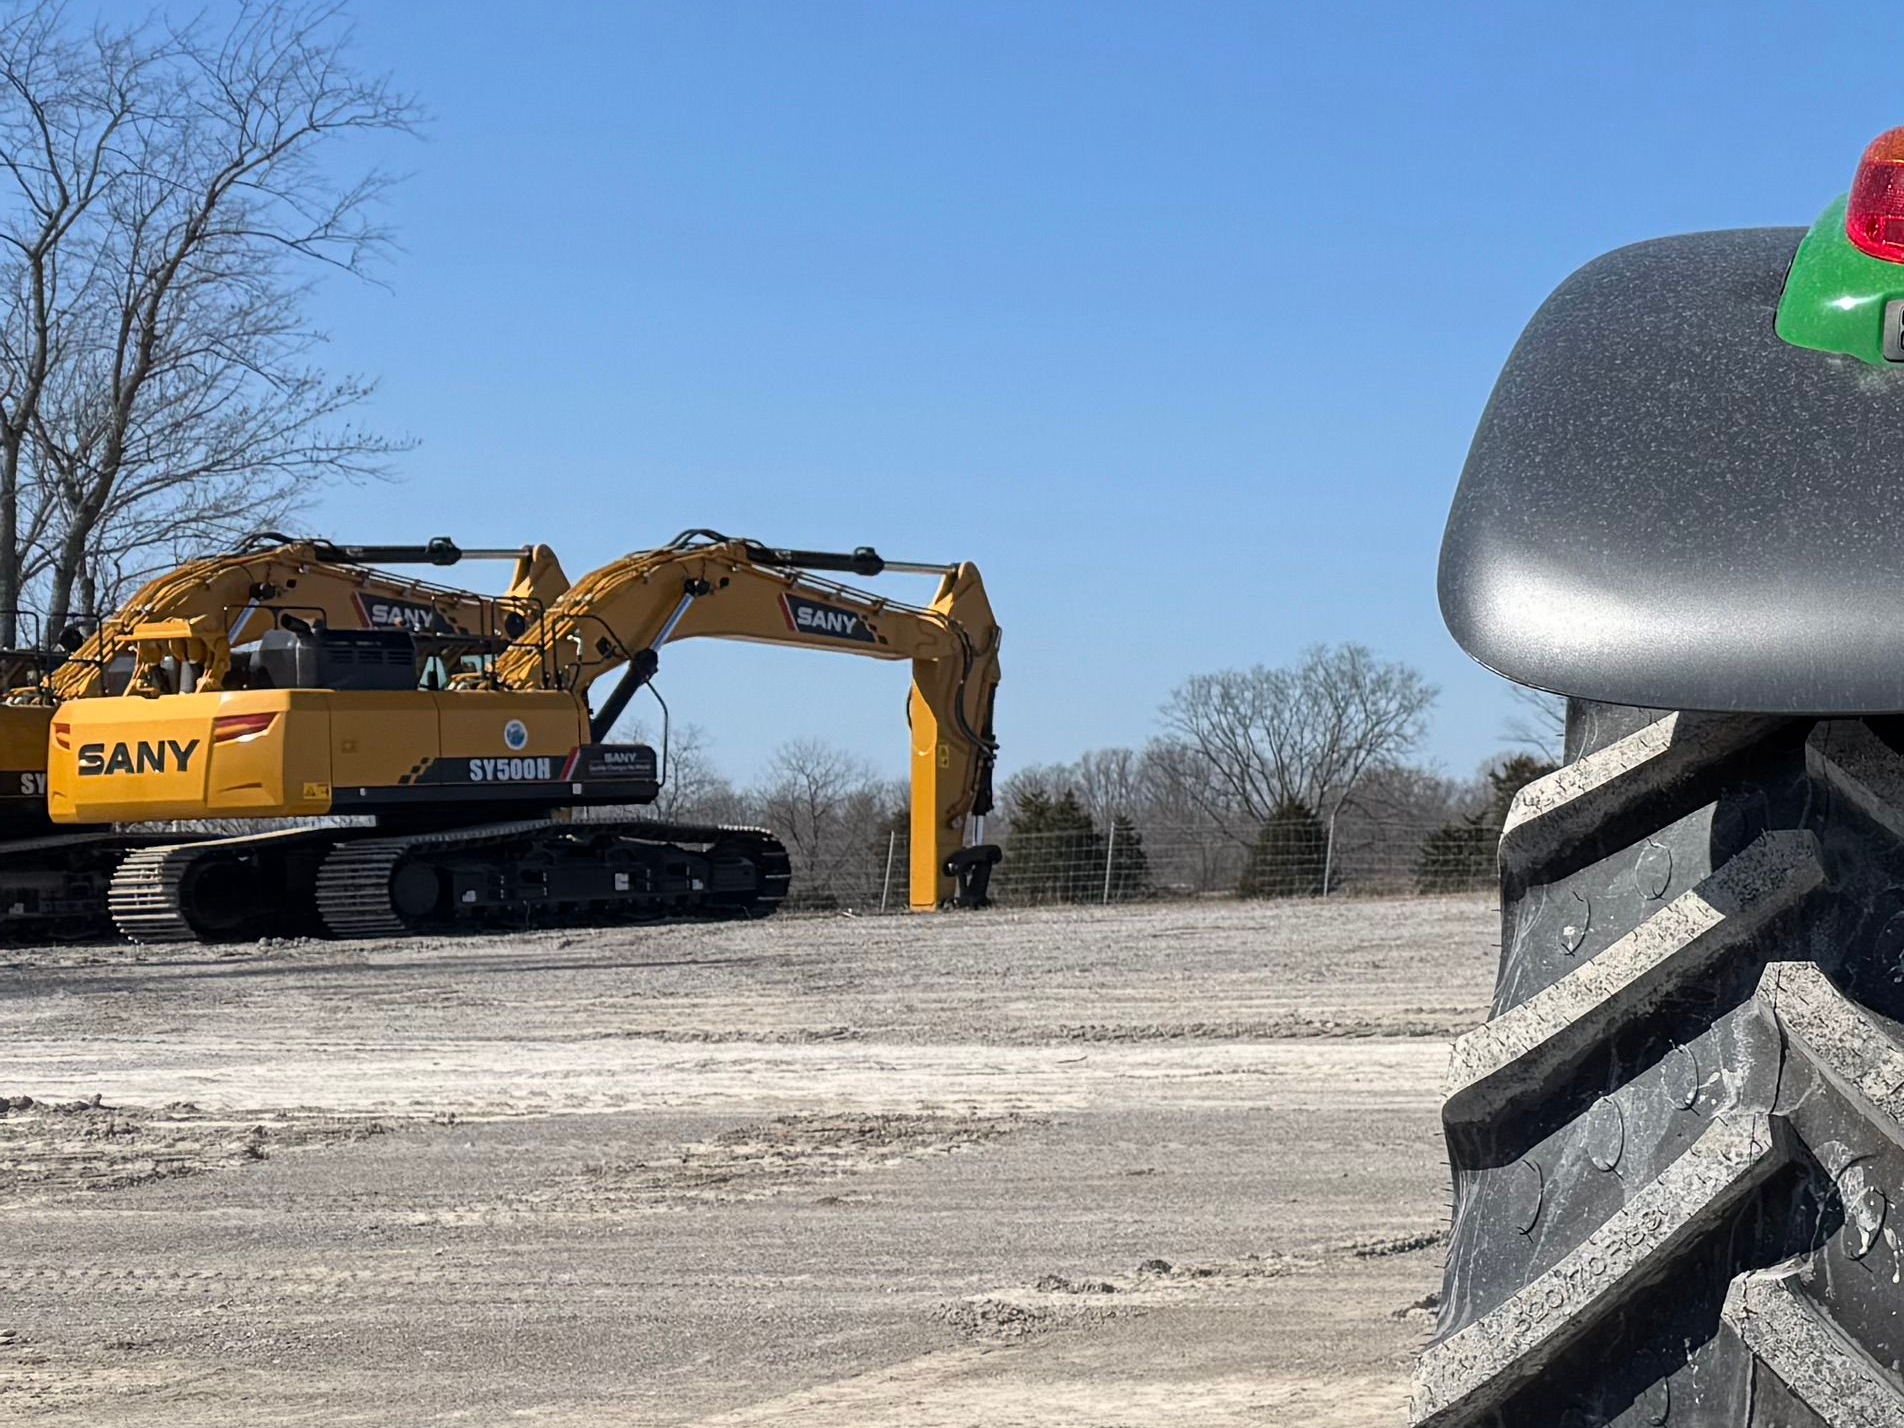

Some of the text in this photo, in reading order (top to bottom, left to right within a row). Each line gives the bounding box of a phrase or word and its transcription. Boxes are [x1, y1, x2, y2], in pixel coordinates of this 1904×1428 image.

[797, 606, 857, 634] SANY
[78, 739, 200, 776] SANY
[469, 757, 550, 781] SY500H
